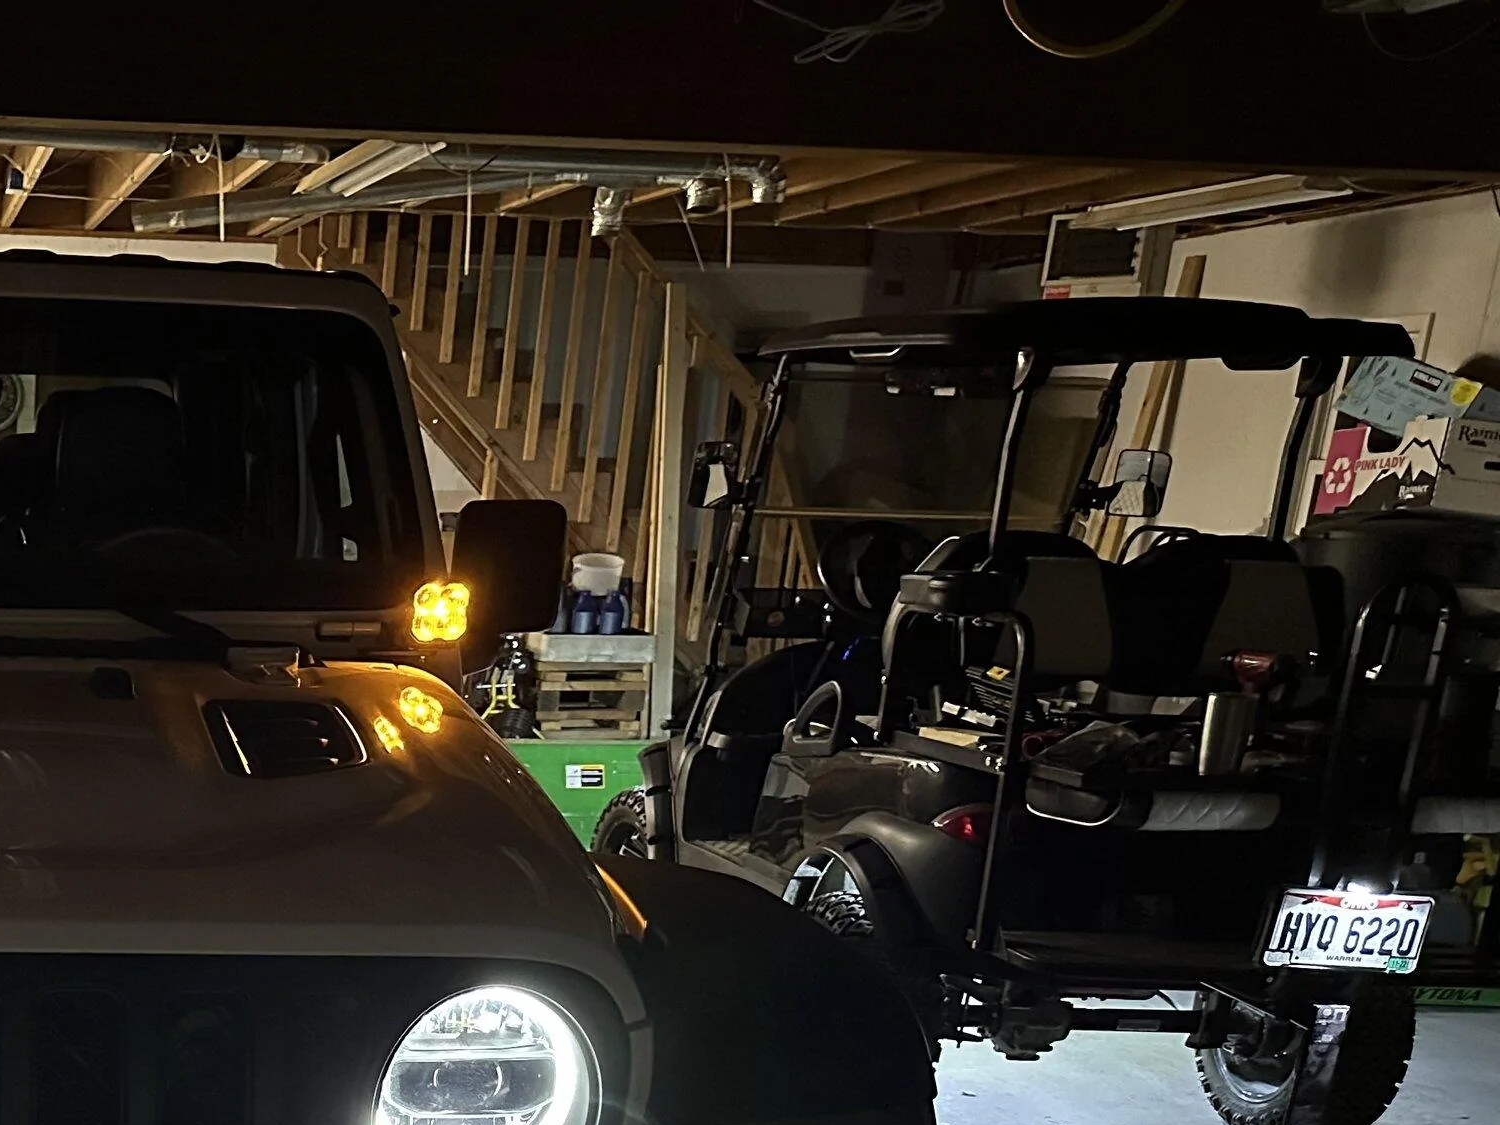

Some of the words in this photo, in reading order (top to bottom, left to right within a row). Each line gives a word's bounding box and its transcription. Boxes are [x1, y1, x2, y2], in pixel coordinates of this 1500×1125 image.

[1355, 459, 1378, 471] PINK
[1379, 456, 1406, 469] LADY
[1277, 911, 1339, 952] HYQ
[1343, 916, 1420, 956] 6220
[1326, 954, 1362, 963] WARREN
